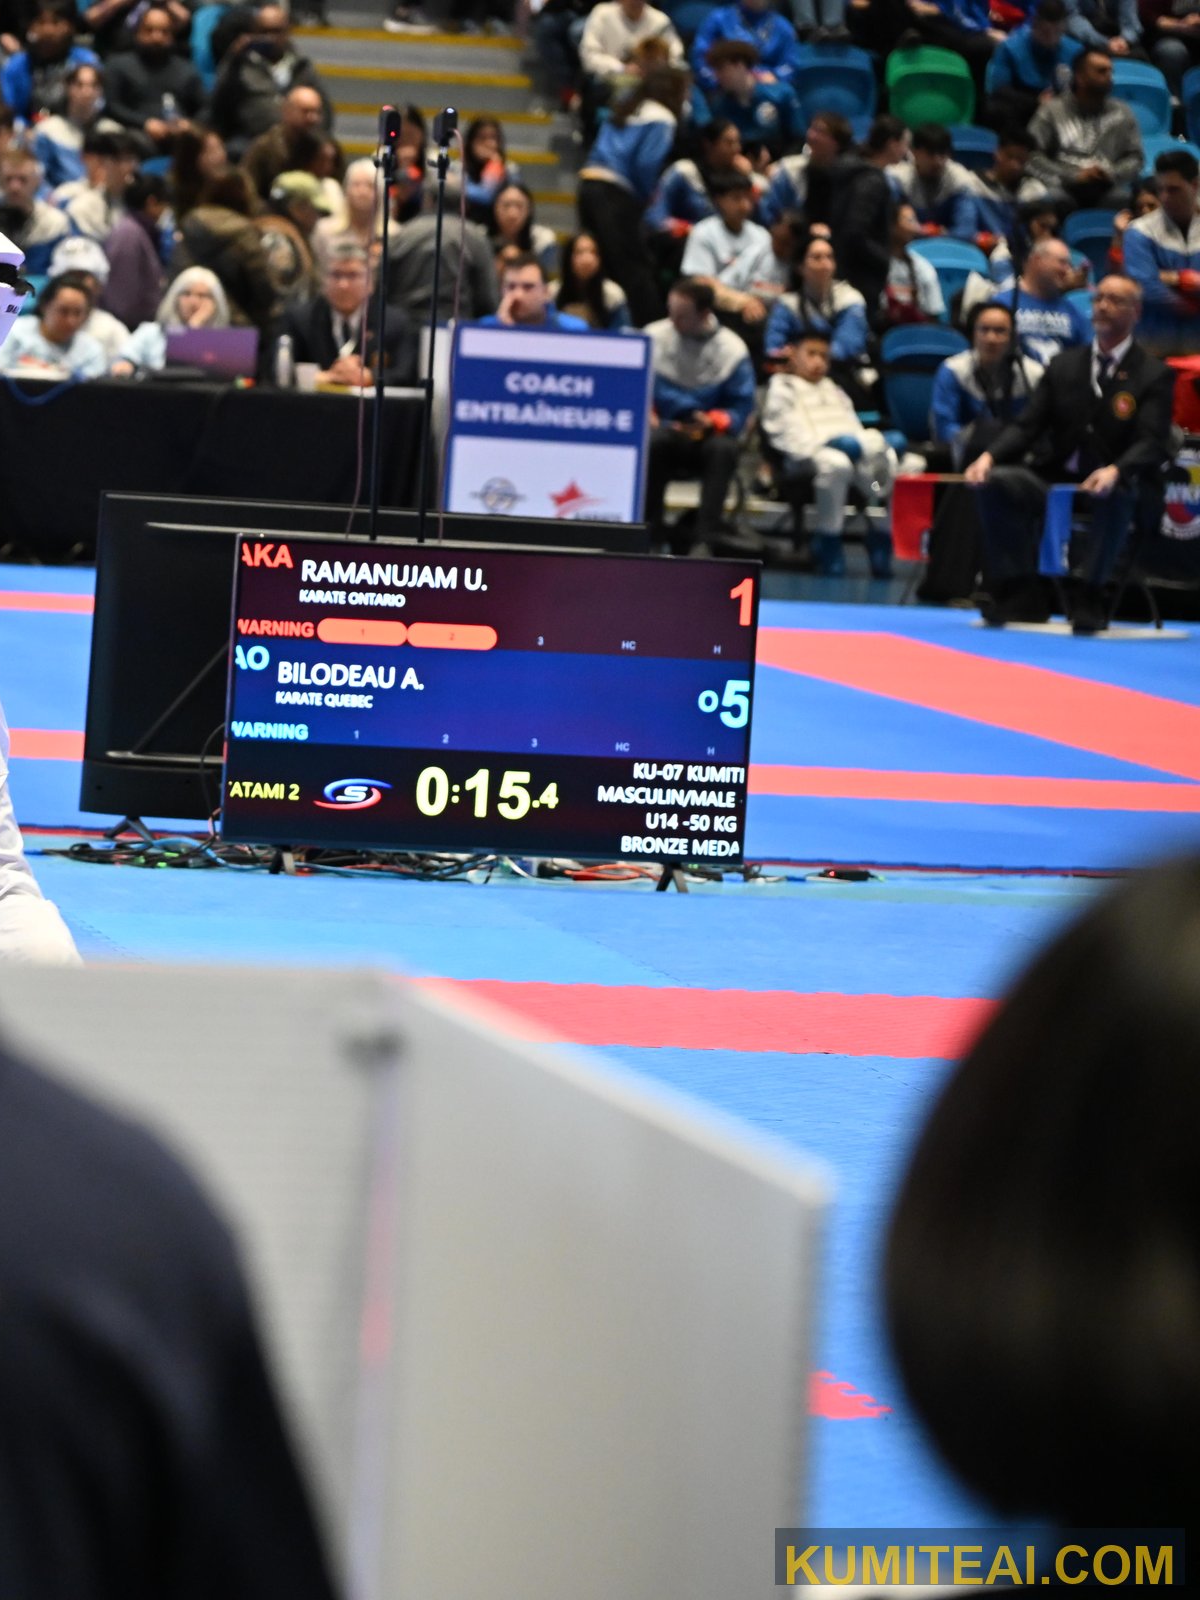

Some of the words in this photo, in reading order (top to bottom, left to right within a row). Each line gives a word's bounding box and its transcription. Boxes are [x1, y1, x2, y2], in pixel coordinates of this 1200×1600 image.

[504, 371, 594, 398] COACH
[241, 543, 293, 569] AKA
[301, 559, 458, 590] RAMANUJAM
[464, 567, 488, 592] U.
[299, 589, 346, 605] KARATE
[348, 592, 406, 608] ONTARIO
[730, 578, 753, 626] 1
[537, 635, 545, 646] 3
[621, 640, 637, 651] HC
[713, 645, 722, 655] H
[235, 644, 270, 671] AO
[277, 661, 396, 689] BILODEAU
[400, 667, 425, 691] A.
[275, 691, 323, 706] KARATE
[324, 693, 374, 709] QUEBEC
[354, 730, 360, 740] 1
[442, 733, 450, 744] 2
[531, 738, 538, 748] 3
[615, 742, 630, 752] HC
[707, 746, 716, 756] H
[633, 762, 684, 781] KU-07
[228, 781, 285, 800] ATAMI
[288, 783, 300, 801] 2
[597, 785, 736, 808] MASCULIN/MALE
[645, 812, 679, 830] U14
[682, 814, 710, 832] -50
[713, 815, 737, 833] KG
[620, 835, 688, 855] BRONZE
[691, 838, 740, 857] MEDA
